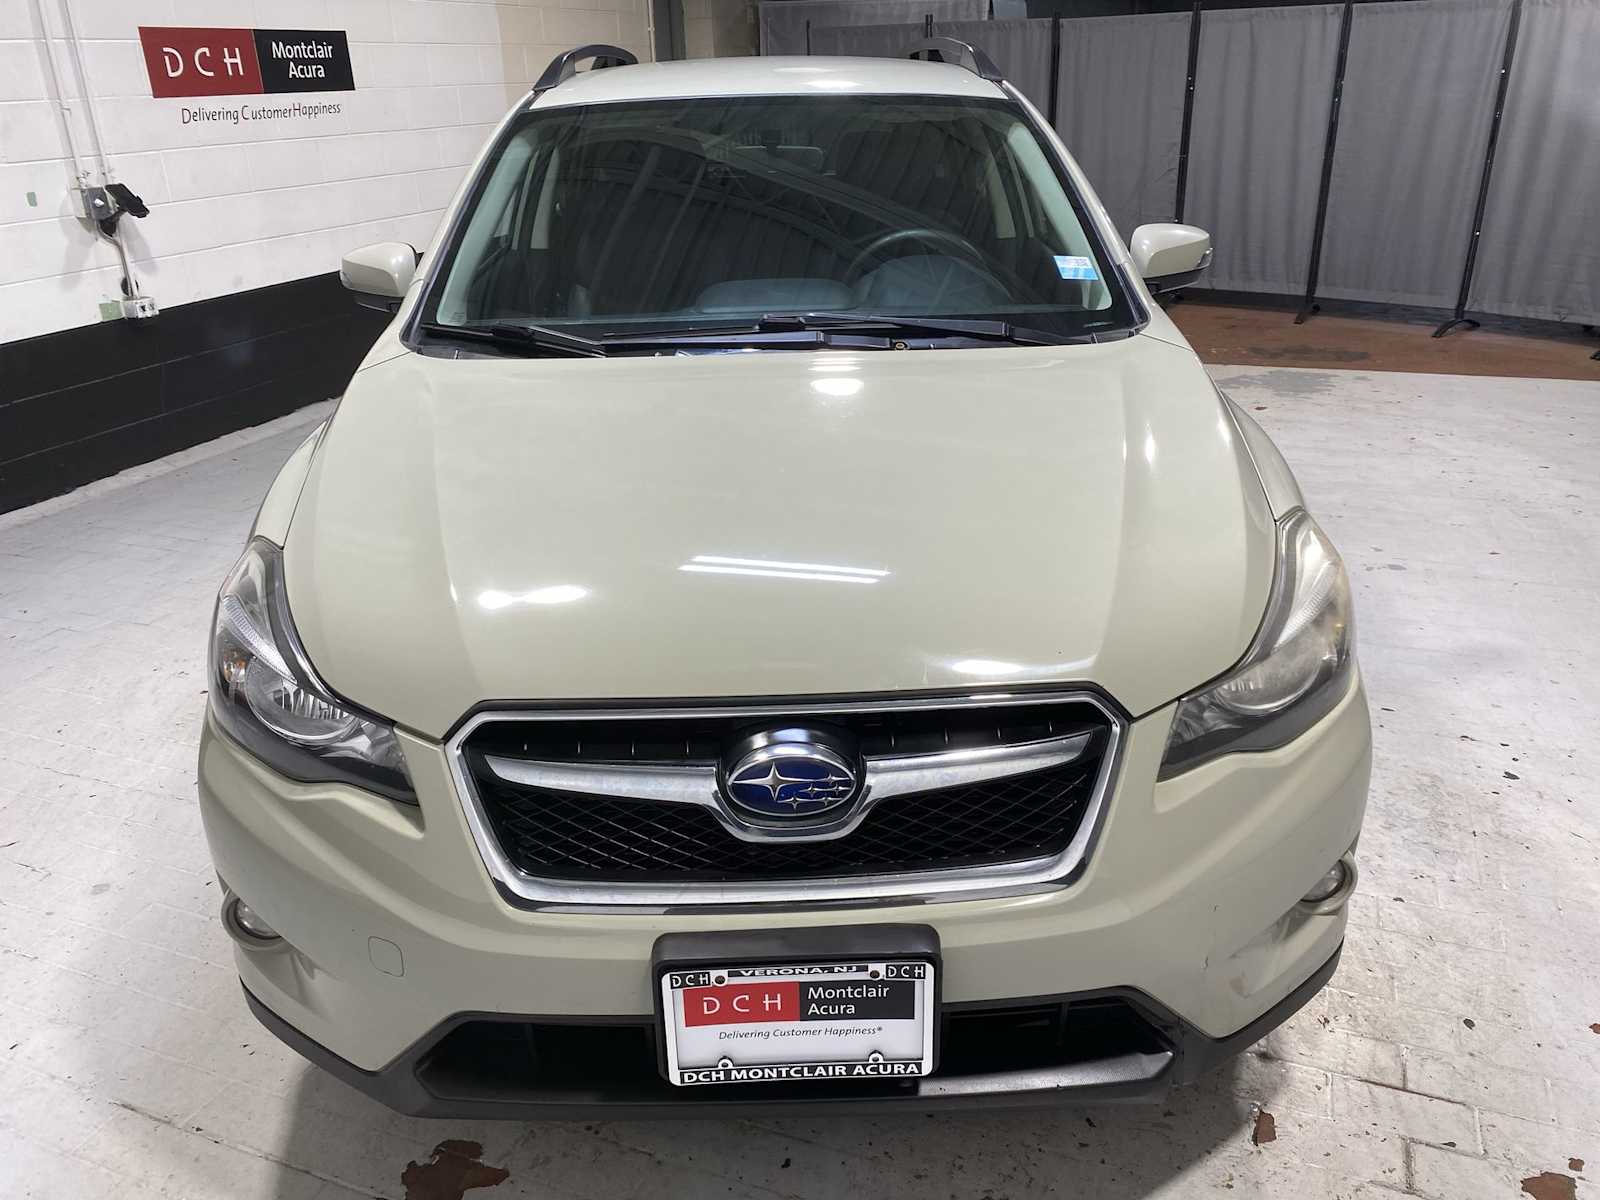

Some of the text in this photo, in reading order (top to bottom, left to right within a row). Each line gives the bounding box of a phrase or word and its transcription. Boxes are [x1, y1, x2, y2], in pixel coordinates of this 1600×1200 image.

[272, 41, 333, 59] Montclair
[162, 47, 244, 77] DCH
[288, 62, 325, 79] Acura
[181, 107, 239, 124] Delivering
[834, 966, 857, 974] NJ
[887, 966, 925, 978] DCH
[671, 974, 709, 987] DCH
[807, 985, 889, 1000] Montclair
[703, 993, 782, 1015] DCH
[807, 1001, 856, 1016] Acura
[718, 1028, 770, 1040] Delivering
[773, 1026, 822, 1038] Customer
[684, 1061, 919, 1083] DCH MONTCLAIR ACURA
